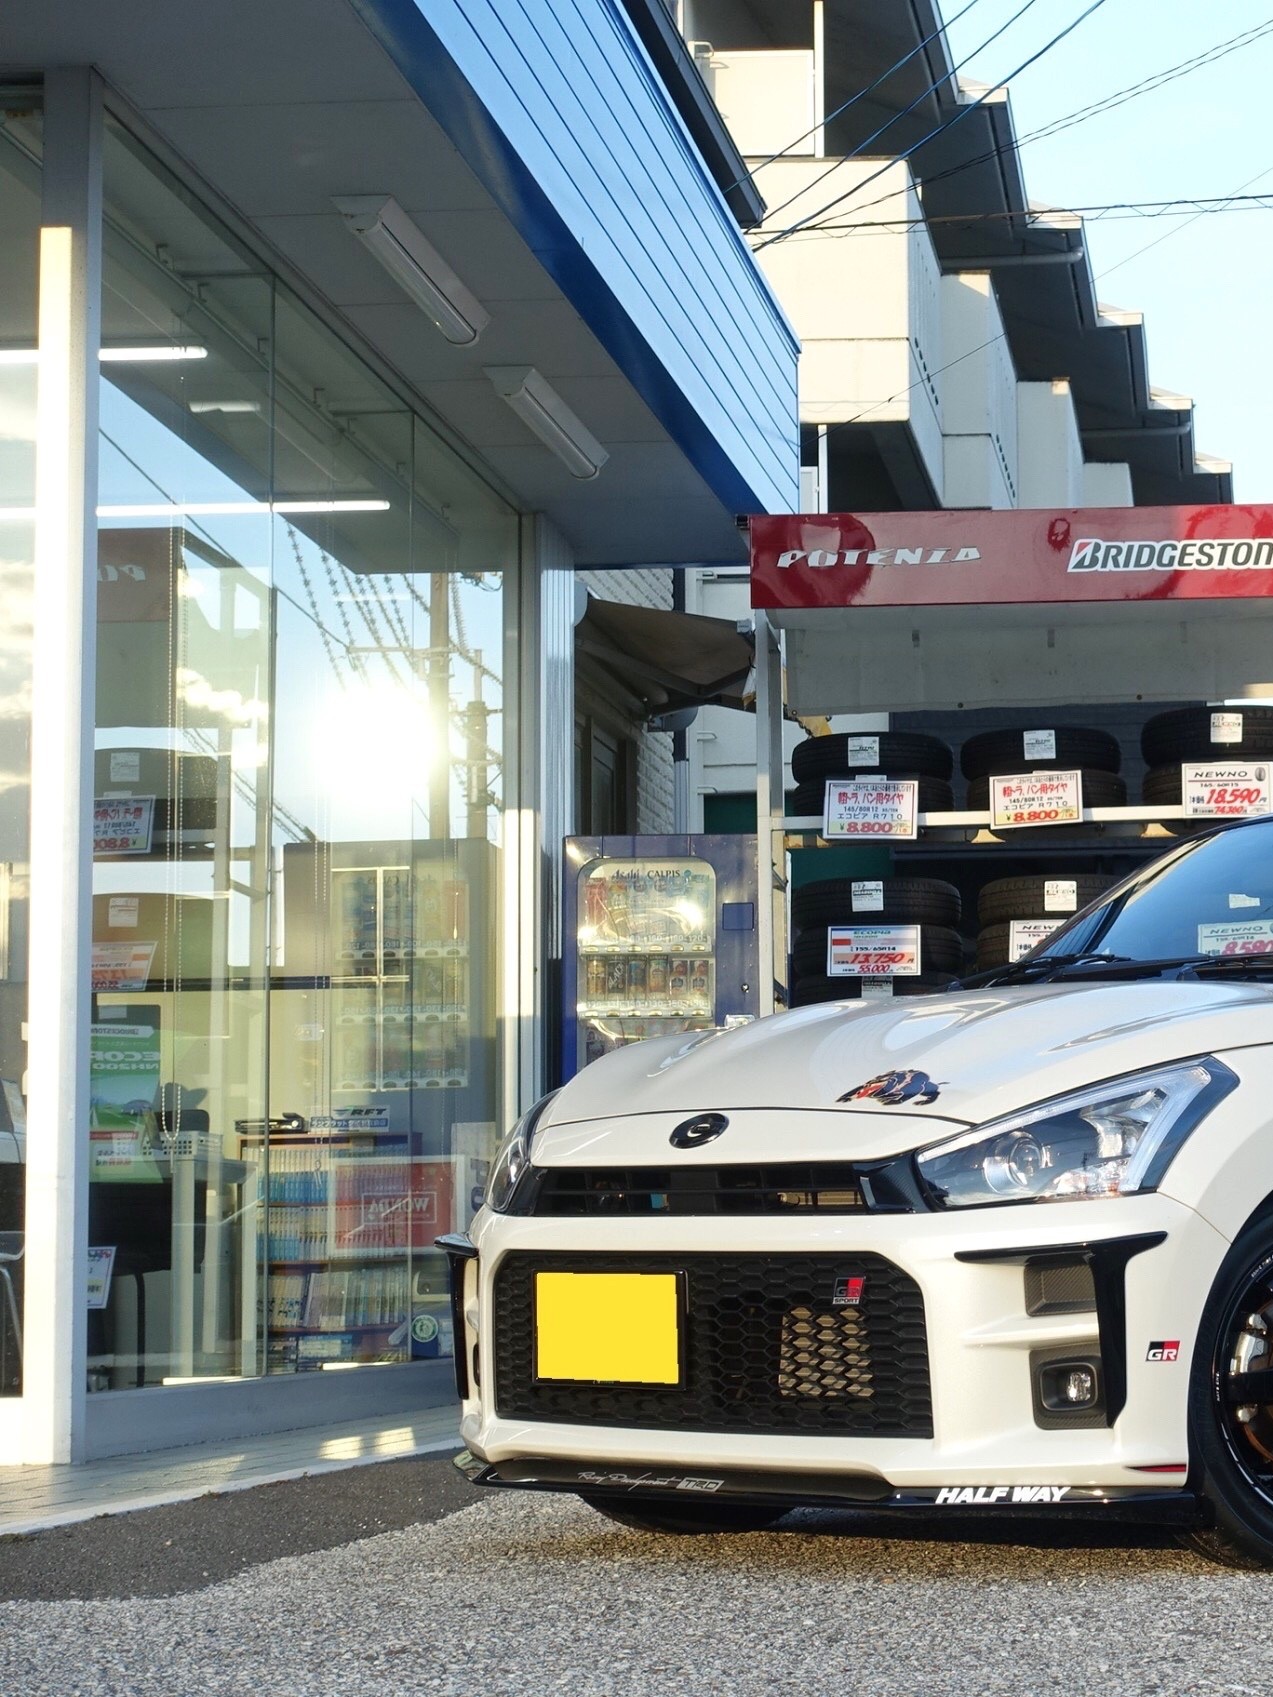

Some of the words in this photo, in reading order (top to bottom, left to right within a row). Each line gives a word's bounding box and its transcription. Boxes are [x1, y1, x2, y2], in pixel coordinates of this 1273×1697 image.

[777, 547, 981, 568] POTENZA
[611, 869, 640, 880] Asahi
[647, 869, 681, 878] CALPIS
[350, 1108, 386, 1116] RFT
[1147, 1348, 1178, 1361] GR
[684, 1478, 719, 1491] TRD
[935, 1486, 1010, 1504] HALF
[1011, 1486, 1072, 1502] WAY
